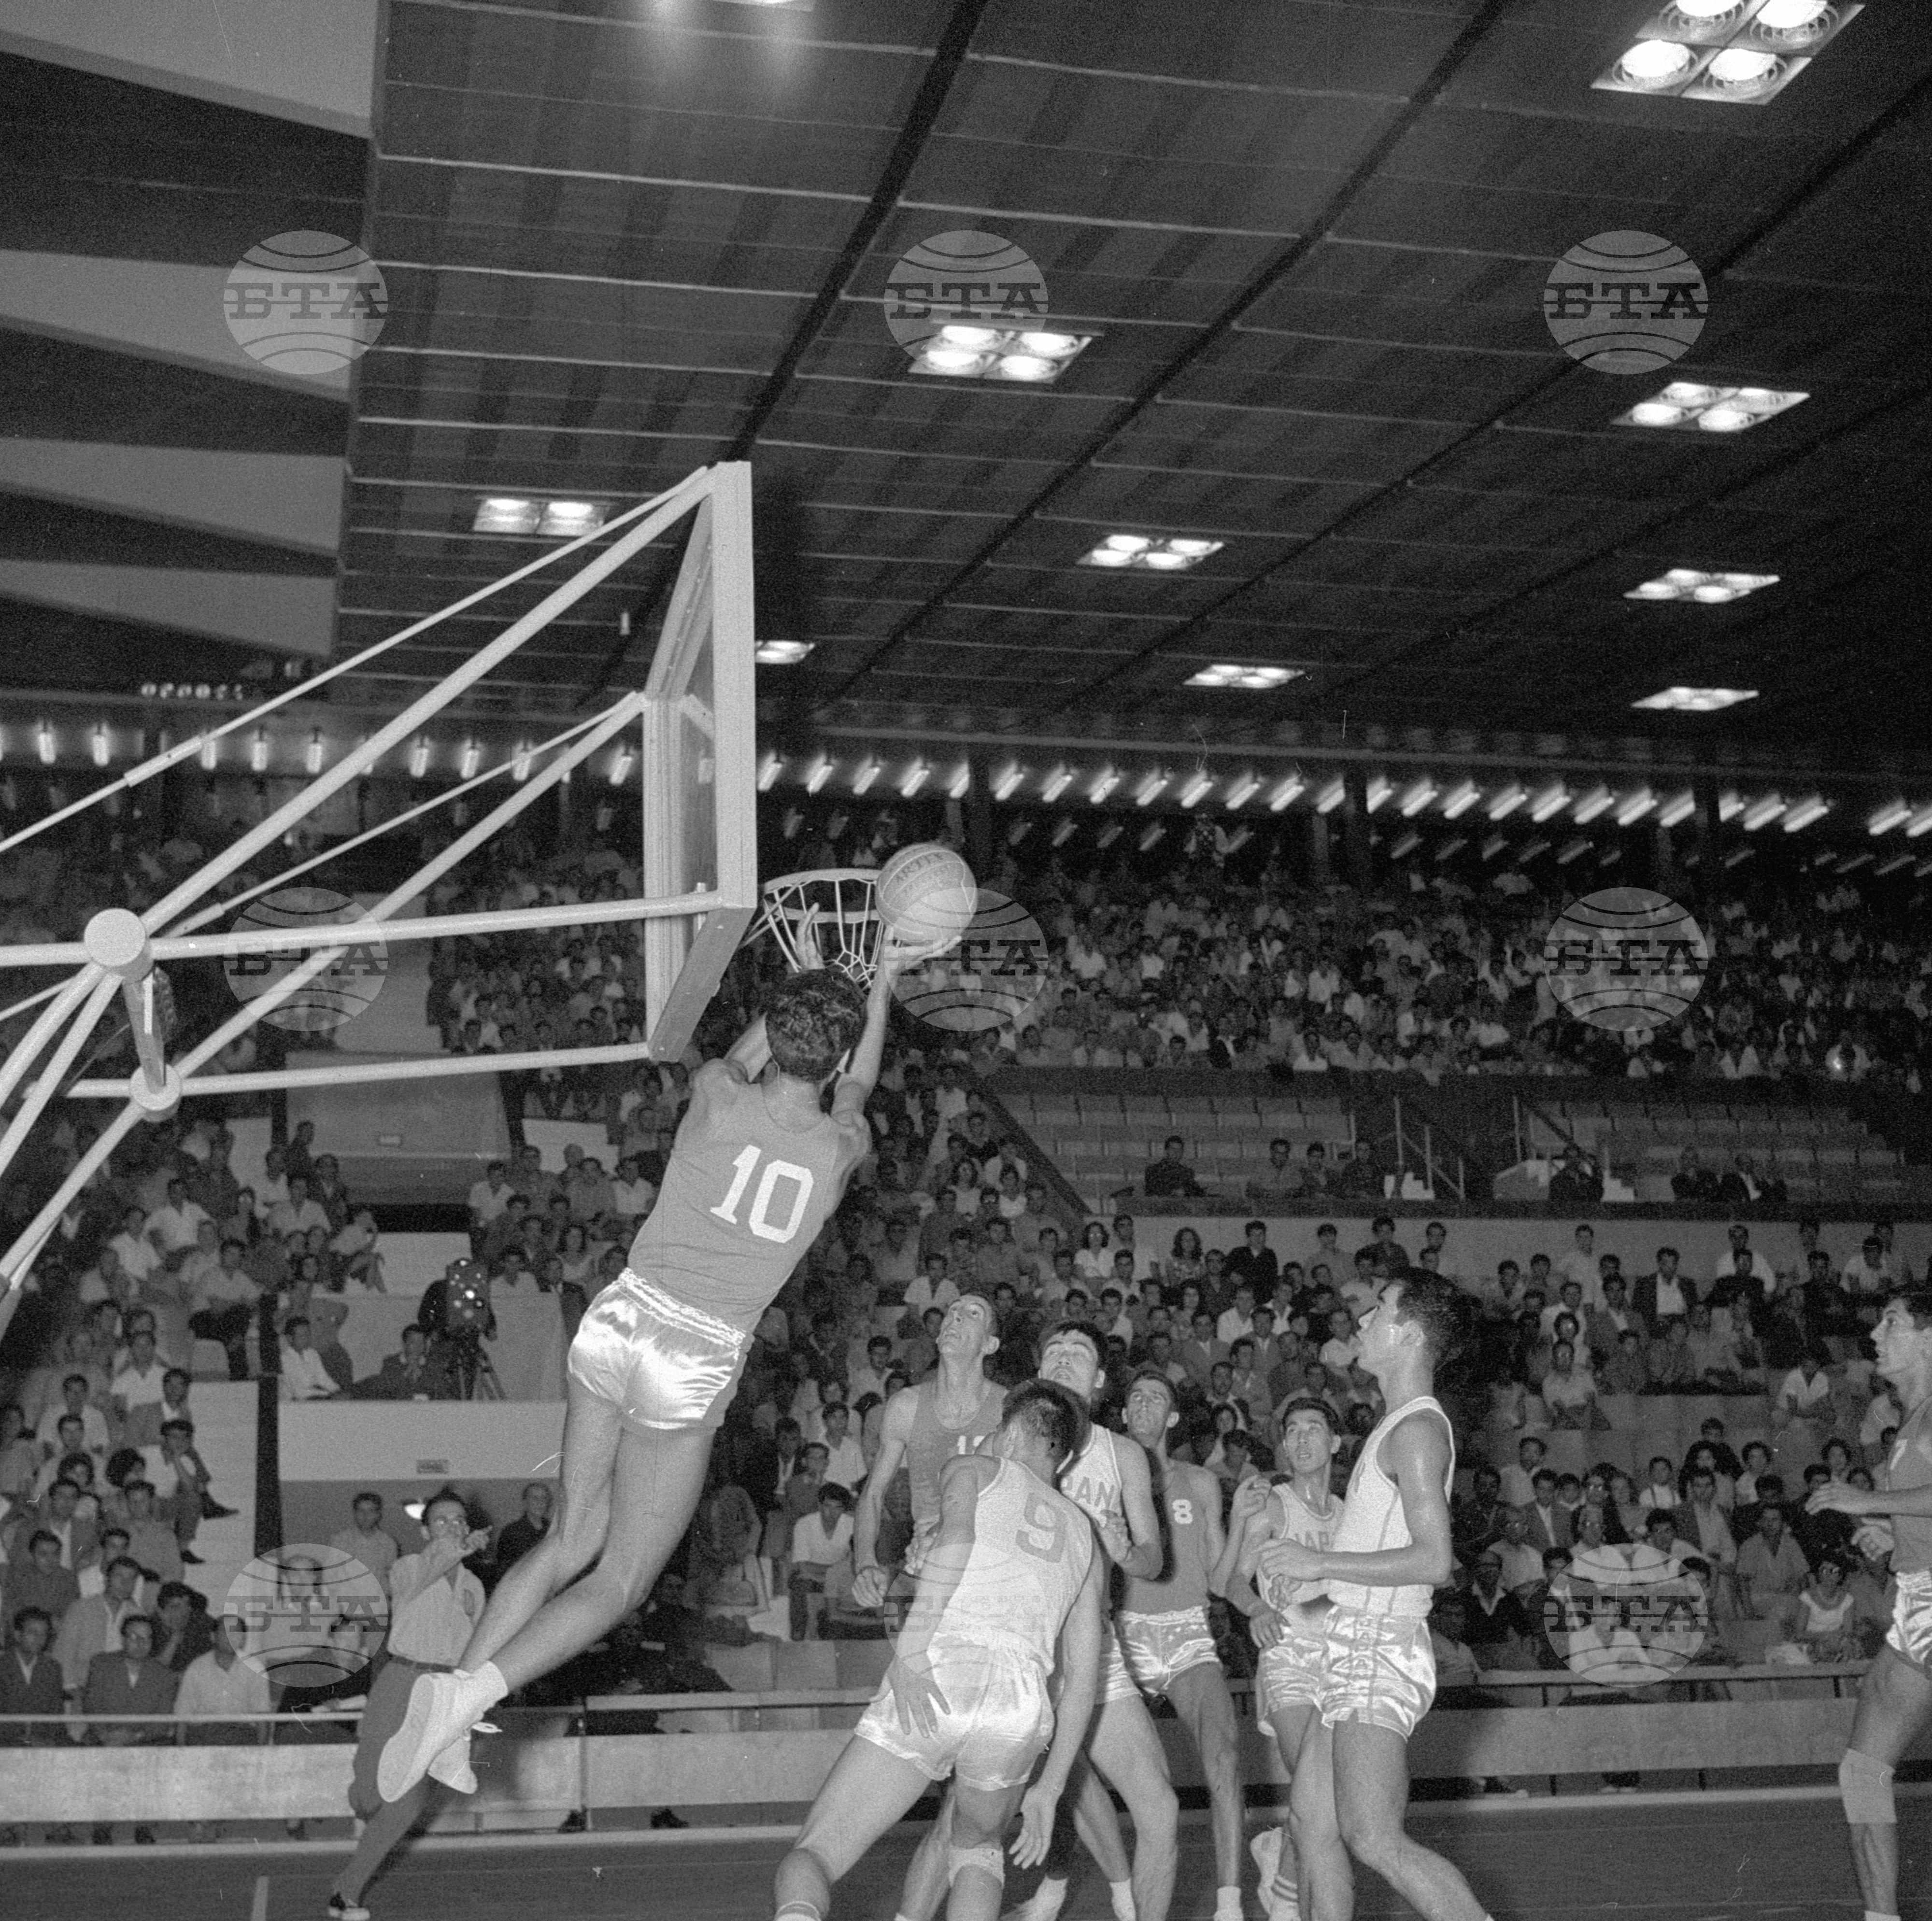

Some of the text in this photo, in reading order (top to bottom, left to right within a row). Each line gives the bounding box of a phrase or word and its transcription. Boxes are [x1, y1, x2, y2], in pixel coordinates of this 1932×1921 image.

[710, 1144, 814, 1243] 10
[1015, 1492, 1066, 1563] 9
[1172, 1498, 1193, 1525] 8
[1294, 1530, 1335, 1553] AP
